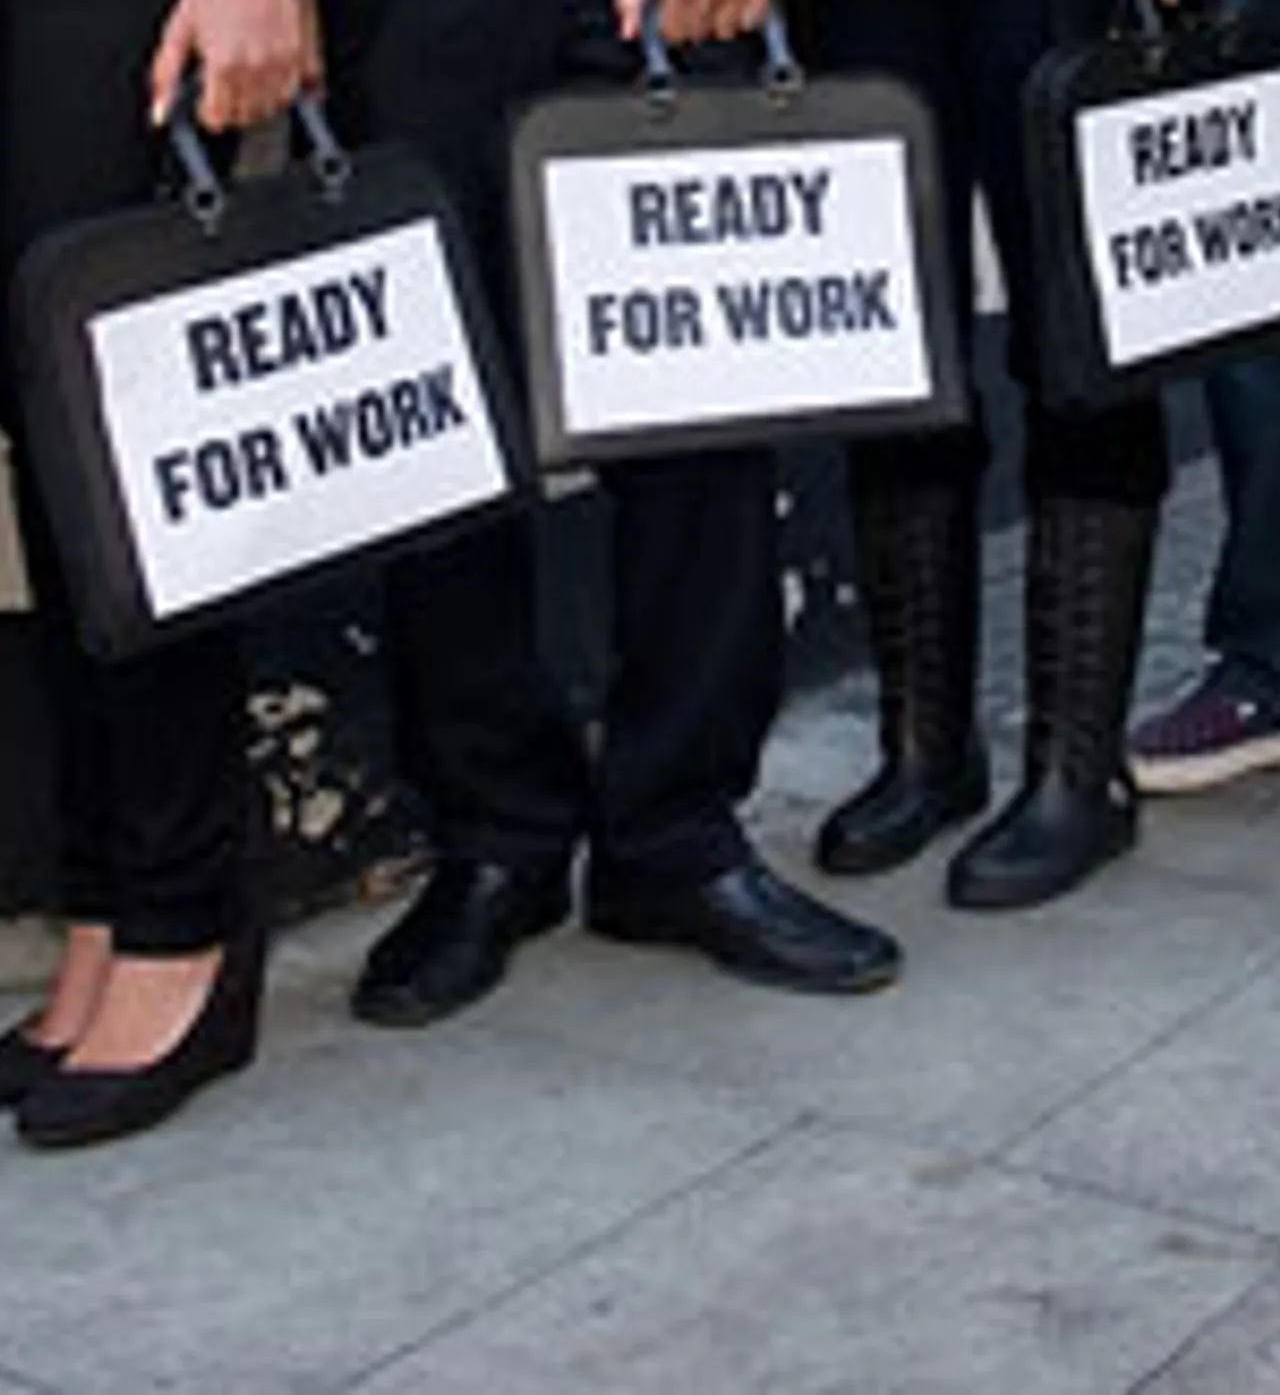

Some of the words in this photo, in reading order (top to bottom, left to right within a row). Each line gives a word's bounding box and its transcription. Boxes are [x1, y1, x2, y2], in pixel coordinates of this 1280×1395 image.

[1131, 99, 1257, 185] READY
[629, 169, 830, 246] READY
[1110, 218, 1194, 288] FOR
[187, 266, 388, 392] READY
[587, 287, 703, 355] FOR
[716, 269, 898, 343] WORK
[153, 429, 289, 525] FOR
[294, 366, 468, 476] WORK
